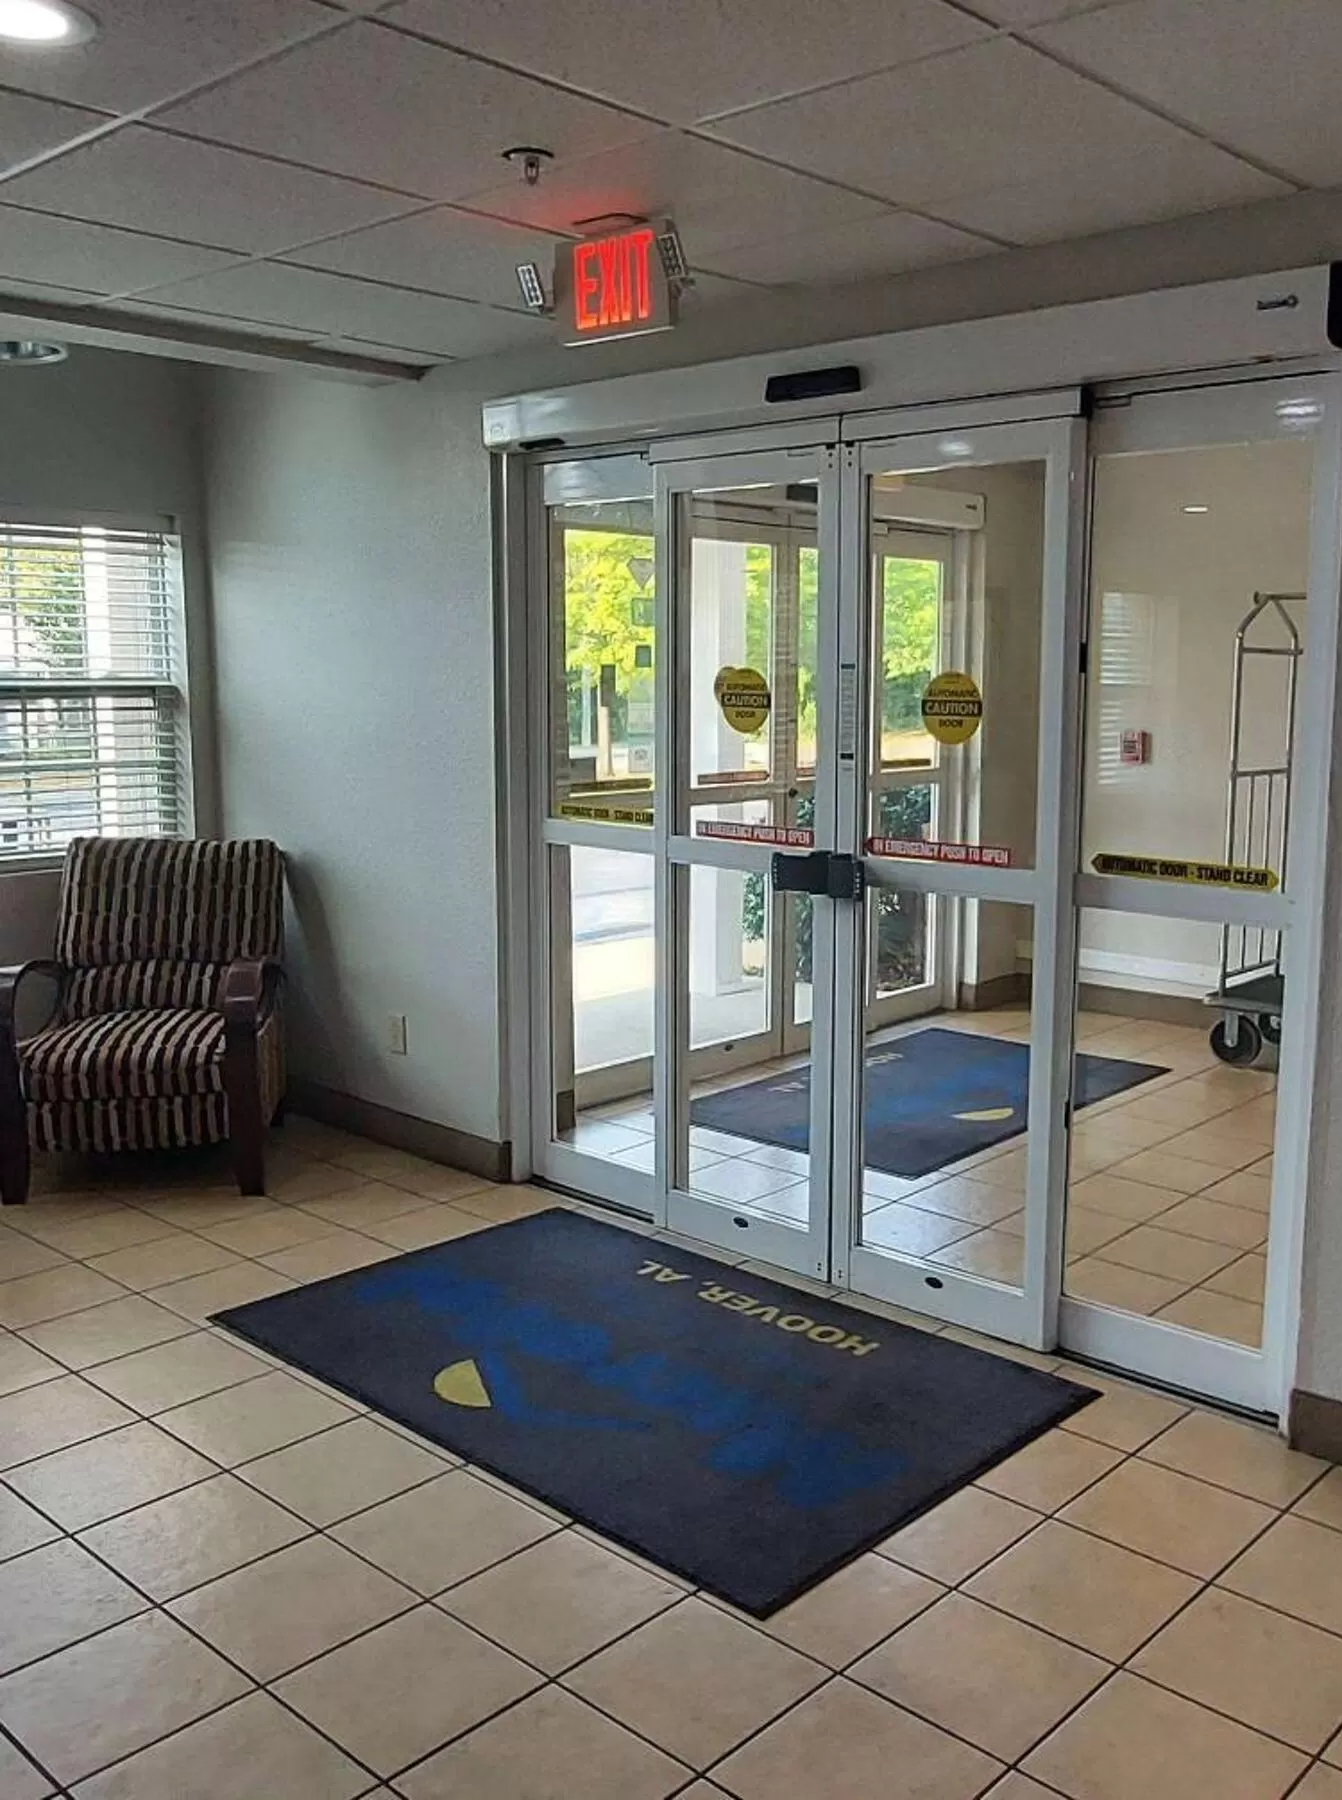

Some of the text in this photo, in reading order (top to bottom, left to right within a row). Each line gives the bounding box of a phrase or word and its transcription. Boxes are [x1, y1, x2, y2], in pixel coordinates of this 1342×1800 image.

[575, 229, 653, 330] EXIT
[724, 694, 769, 707] CAUTION
[925, 701, 979, 714] CAUTION
[939, 719, 963, 728] DOOR
[788, 831, 811, 845] OPEN
[885, 840, 940, 858] EMERGENCY
[941, 845, 967, 860] PUSH
[969, 847, 980, 861] TO
[982, 849, 1009, 864] OPEN
[1102, 855, 1158, 875] AUTOMATIC
[1159, 861, 1188, 878] DOOR
[1196, 865, 1232, 883] STAND
[1233, 868, 1269, 887] CLEAR
[637, 1260, 880, 1356] HOOVER, AL
